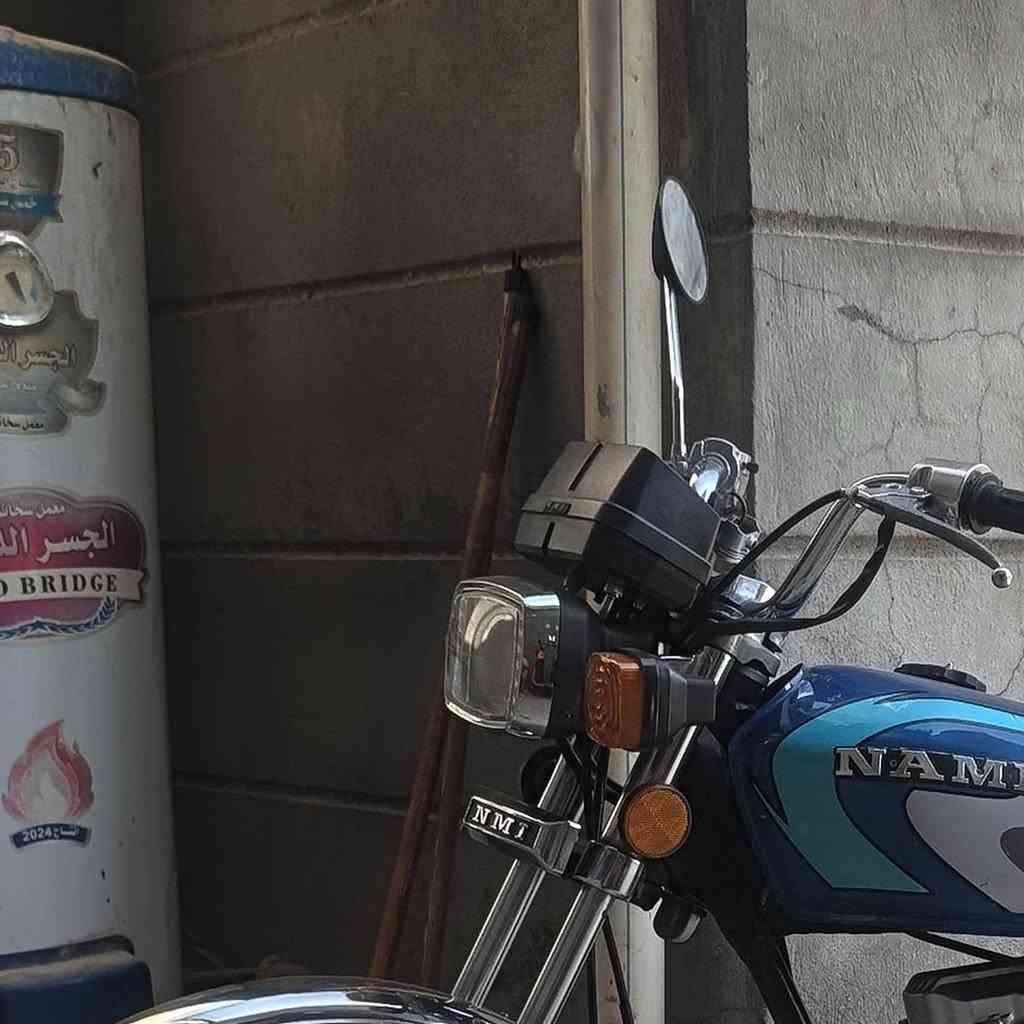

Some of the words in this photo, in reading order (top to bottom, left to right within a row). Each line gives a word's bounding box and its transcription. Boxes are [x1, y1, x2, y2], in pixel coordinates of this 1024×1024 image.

[36, 519, 116, 564] الجسر
[20, 574, 118, 595] BRIDGE
[22, 826, 52, 842] 2024
